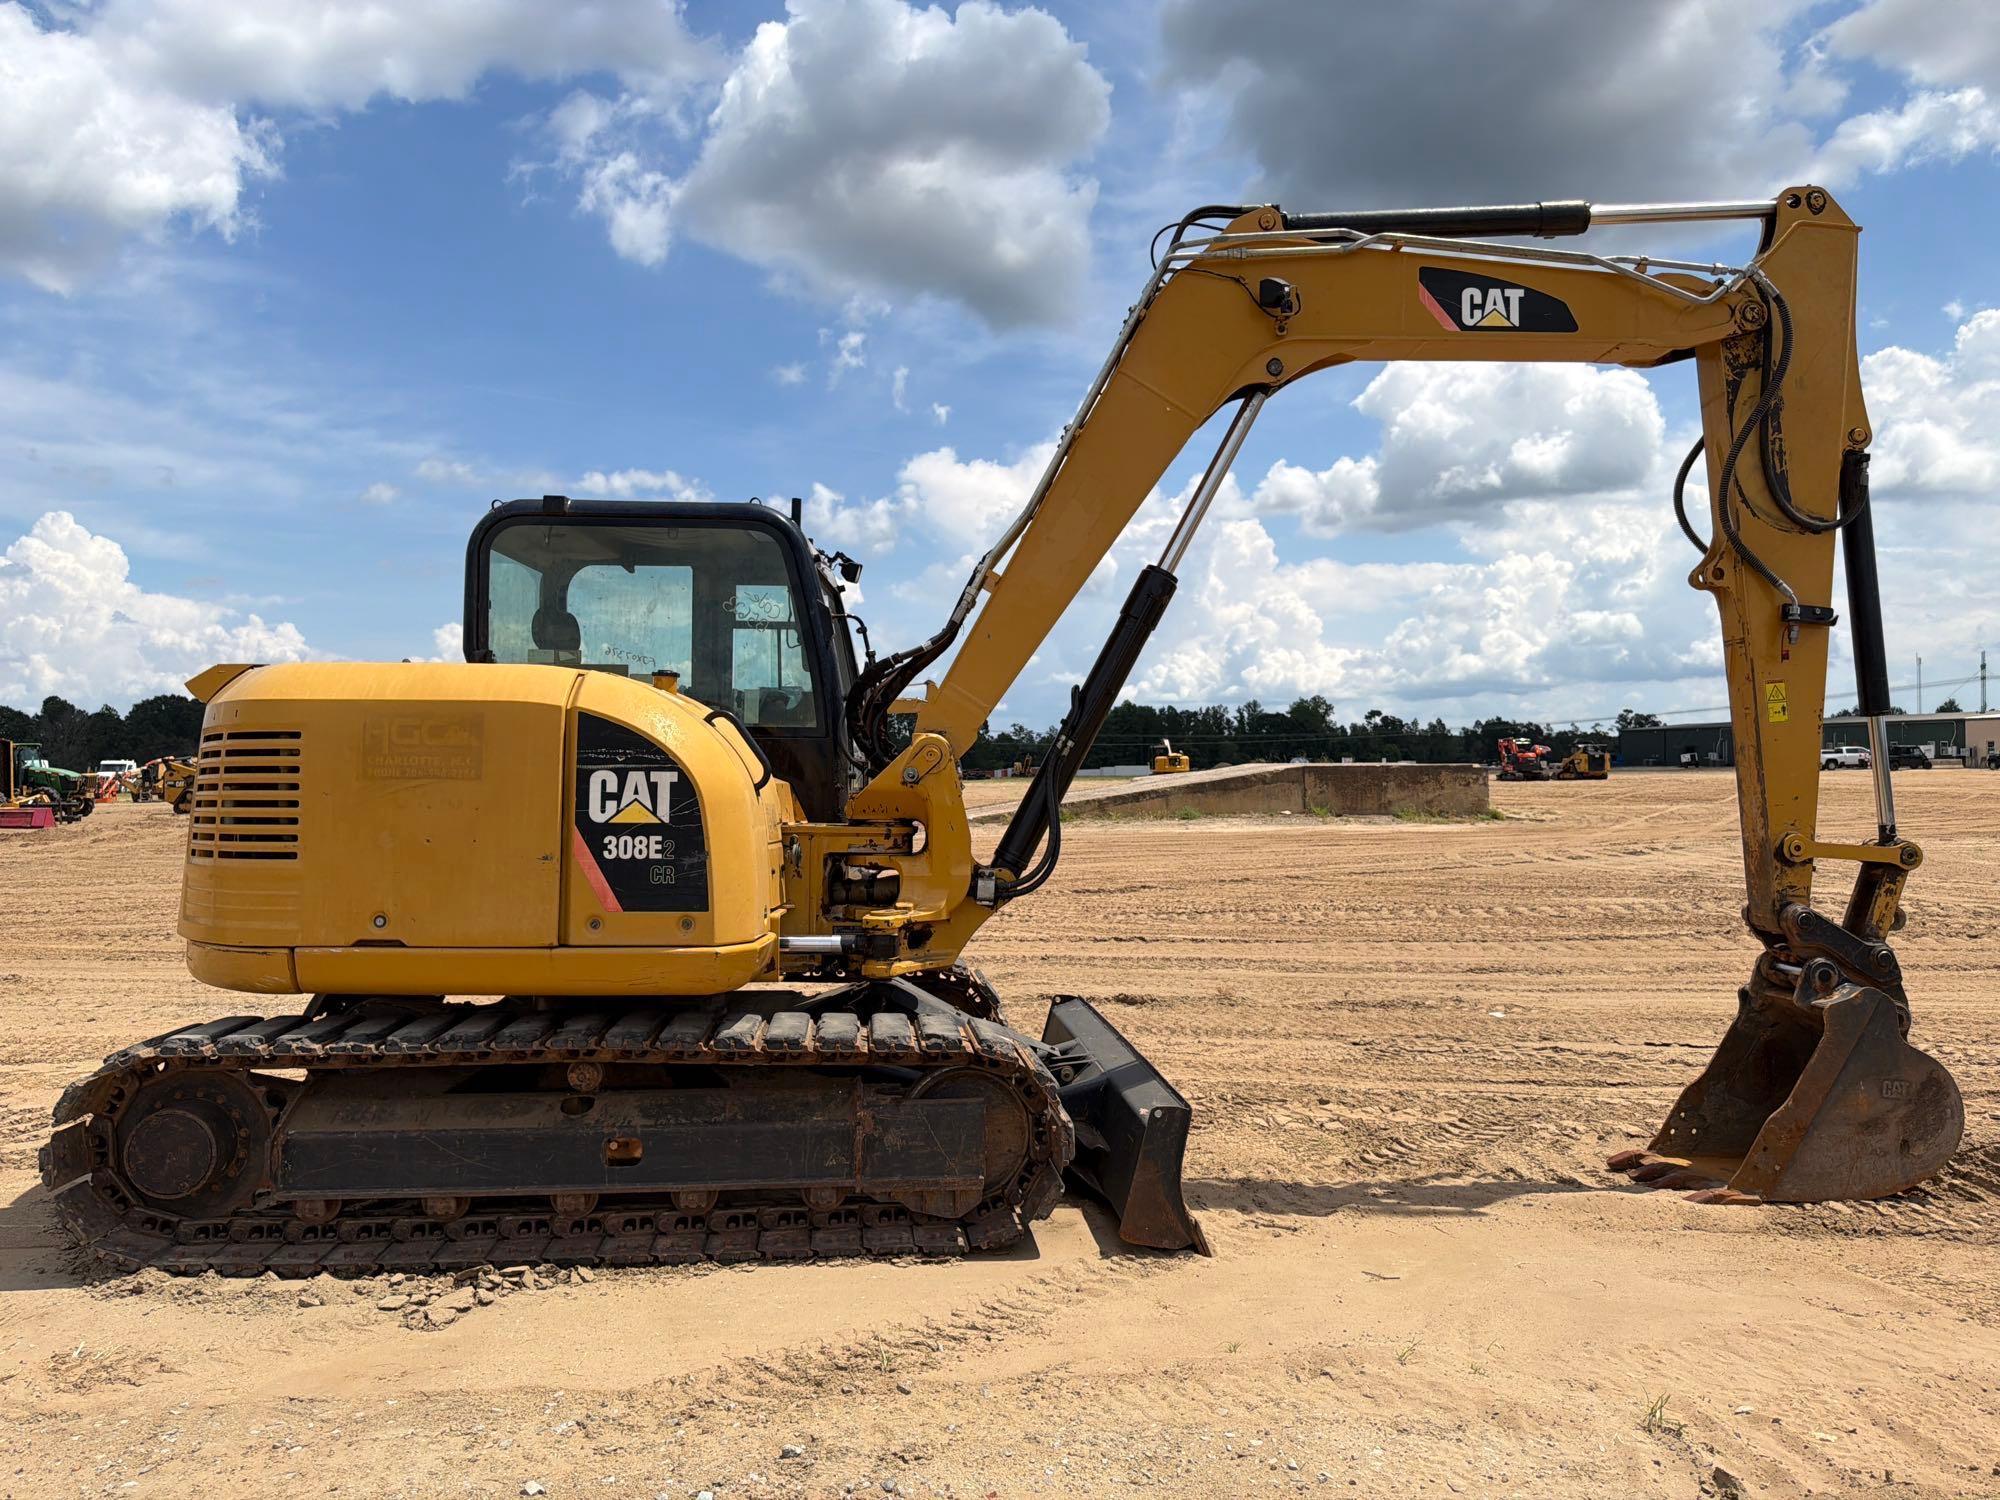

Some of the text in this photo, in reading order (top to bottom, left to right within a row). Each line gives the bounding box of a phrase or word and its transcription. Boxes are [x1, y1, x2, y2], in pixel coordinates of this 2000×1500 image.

[1461, 287, 1525, 327] CAT
[588, 769, 679, 824] CAT
[603, 835, 675, 860] 308E2
[650, 865, 675, 885] CR
[1882, 1080, 1910, 1098] CAT
